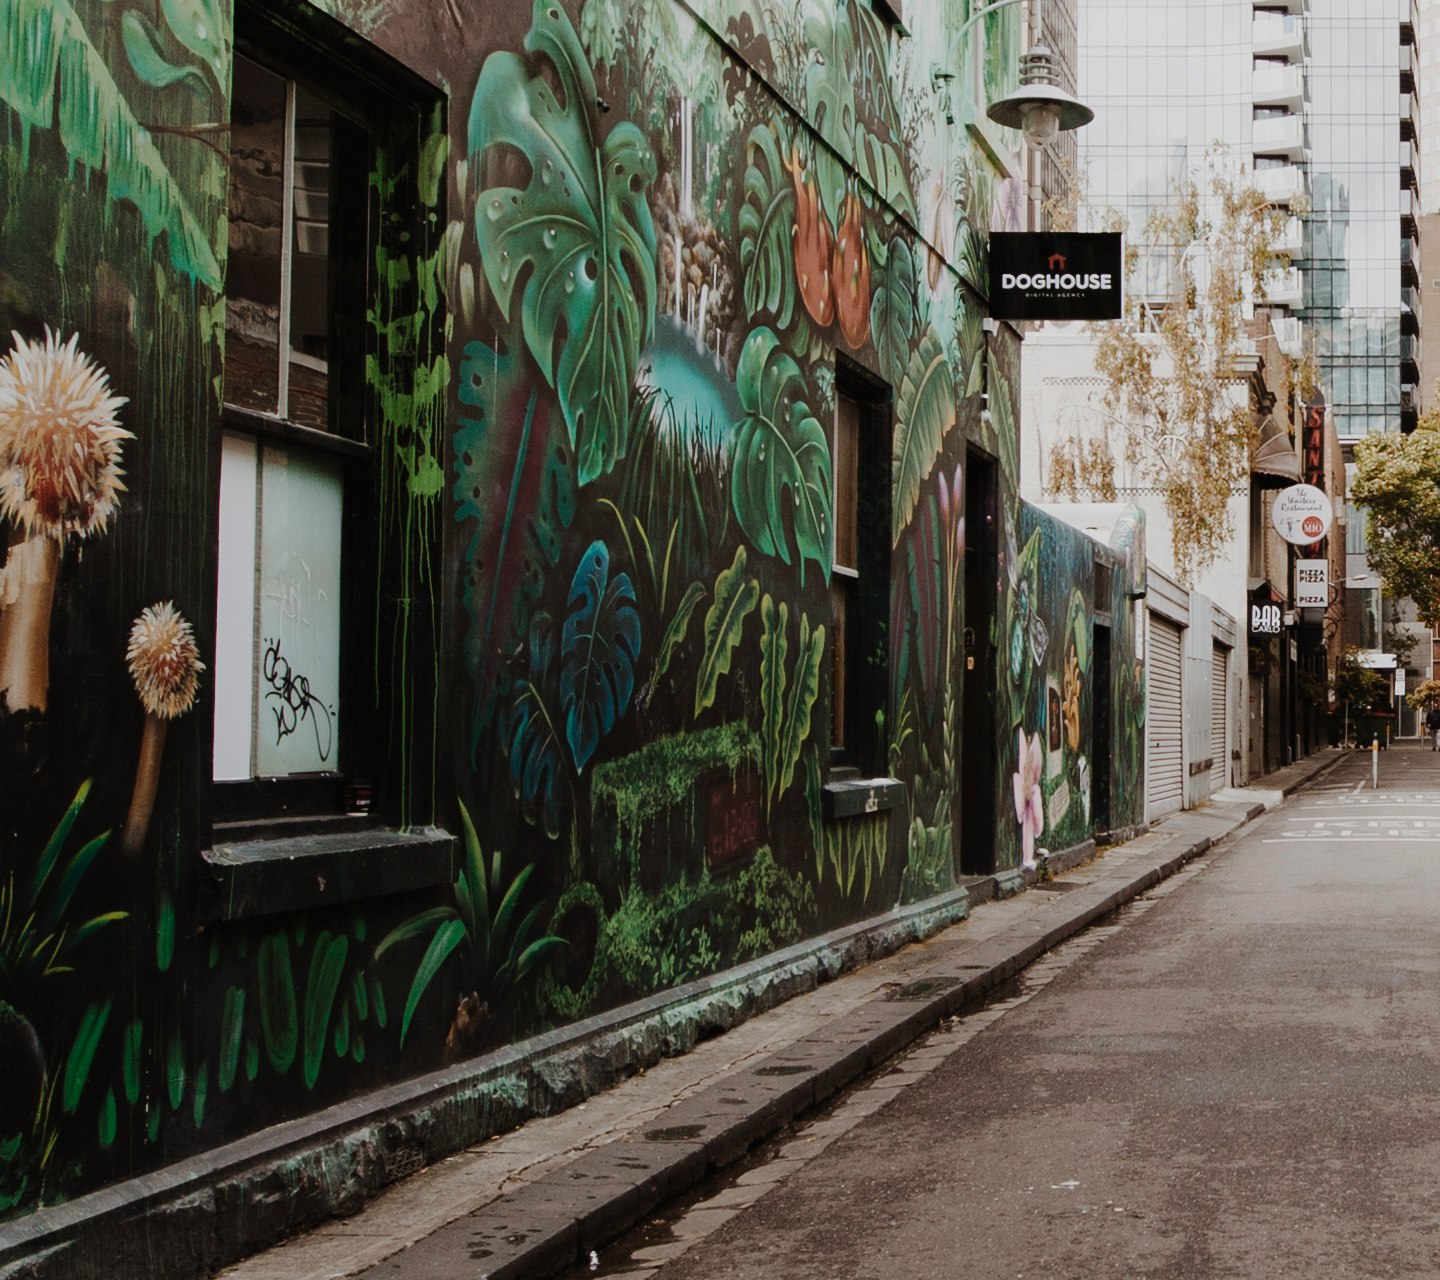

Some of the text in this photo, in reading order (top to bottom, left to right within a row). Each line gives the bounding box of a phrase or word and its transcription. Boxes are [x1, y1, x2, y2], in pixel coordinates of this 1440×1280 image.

[1001, 273, 1112, 290] DOGHOUSE
[1296, 488, 1307, 497] The
[1280, 502, 1323, 512] Restaurant
[1251, 605, 1281, 626] BAR
[1251, 625, 1281, 634] CARLO
